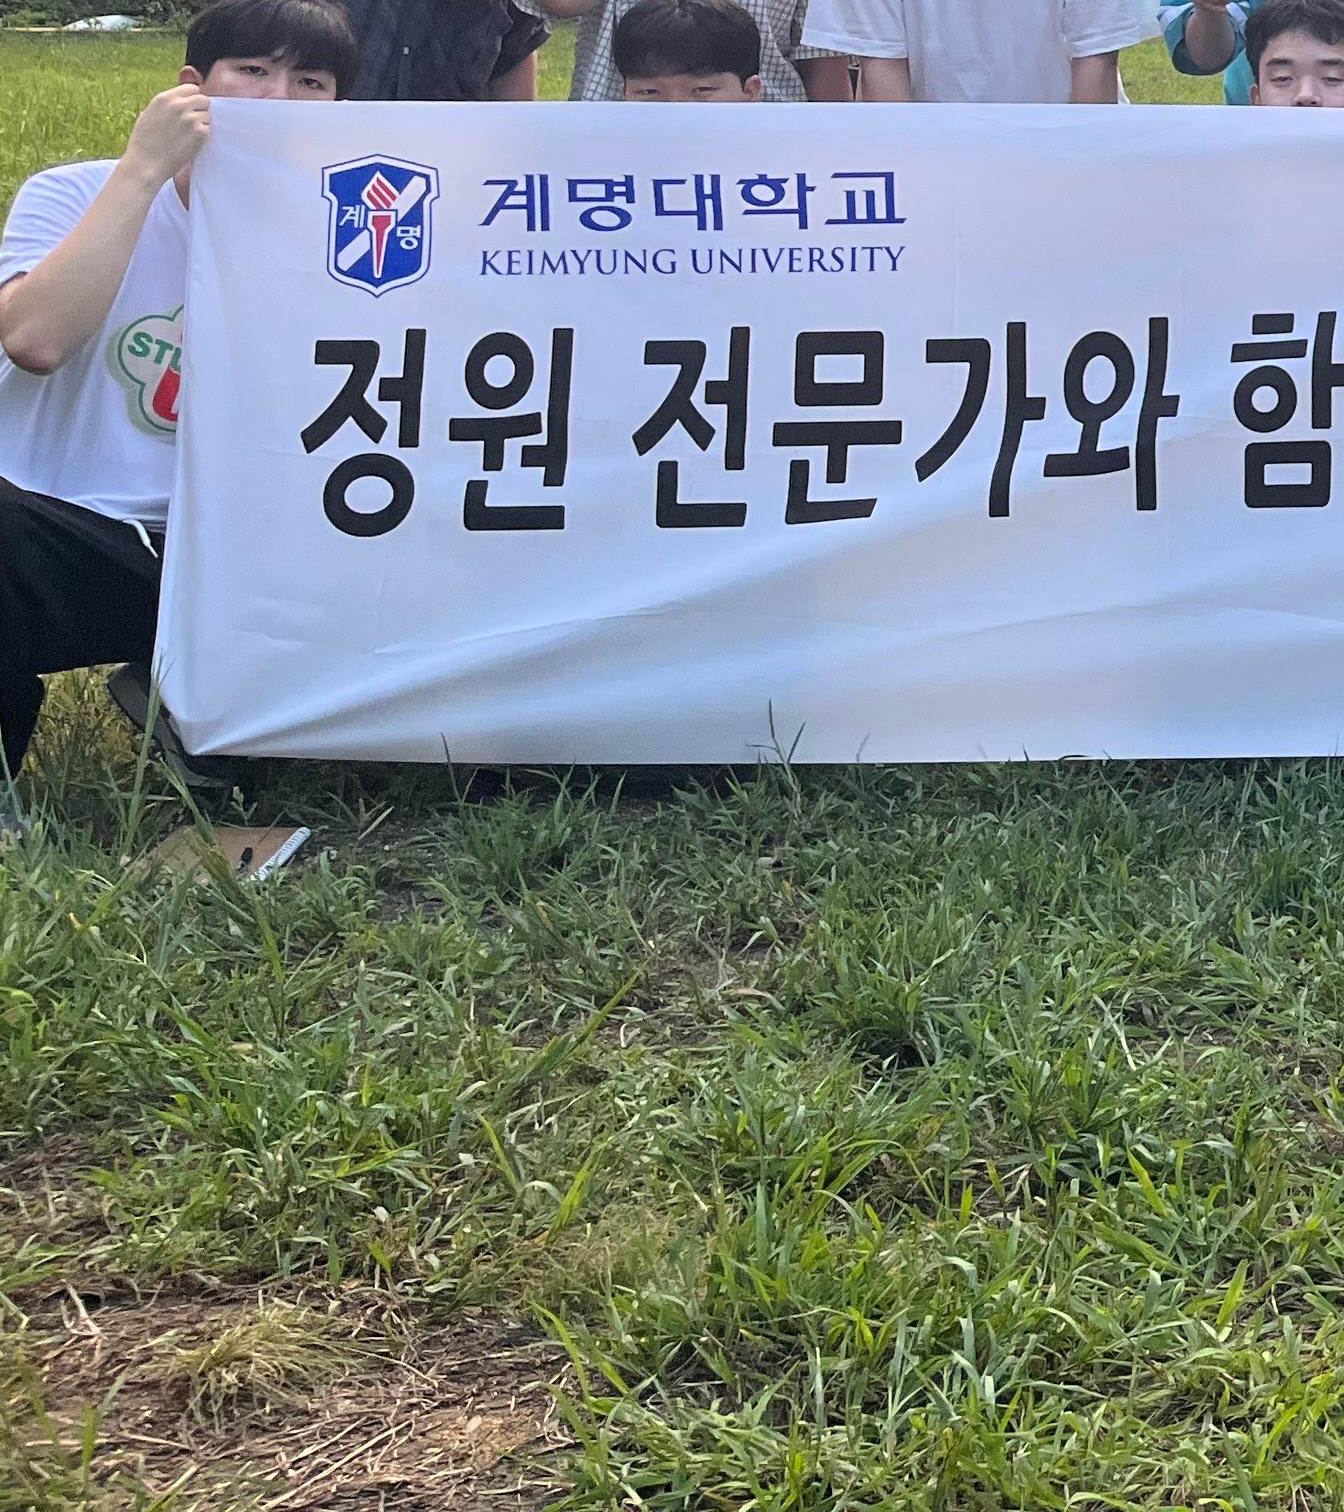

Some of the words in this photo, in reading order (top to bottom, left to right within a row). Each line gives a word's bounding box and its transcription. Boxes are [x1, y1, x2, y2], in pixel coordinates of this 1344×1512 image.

[338, 204, 366, 229] 계
[478, 171, 908, 232] 계명대학교
[396, 224, 422, 251] 명
[480, 248, 677, 276] KEIMYUNG
[690, 245, 906, 275] UNIVERSITY
[300, 326, 575, 538] 정원
[631, 316, 1181, 529] 전문가와
